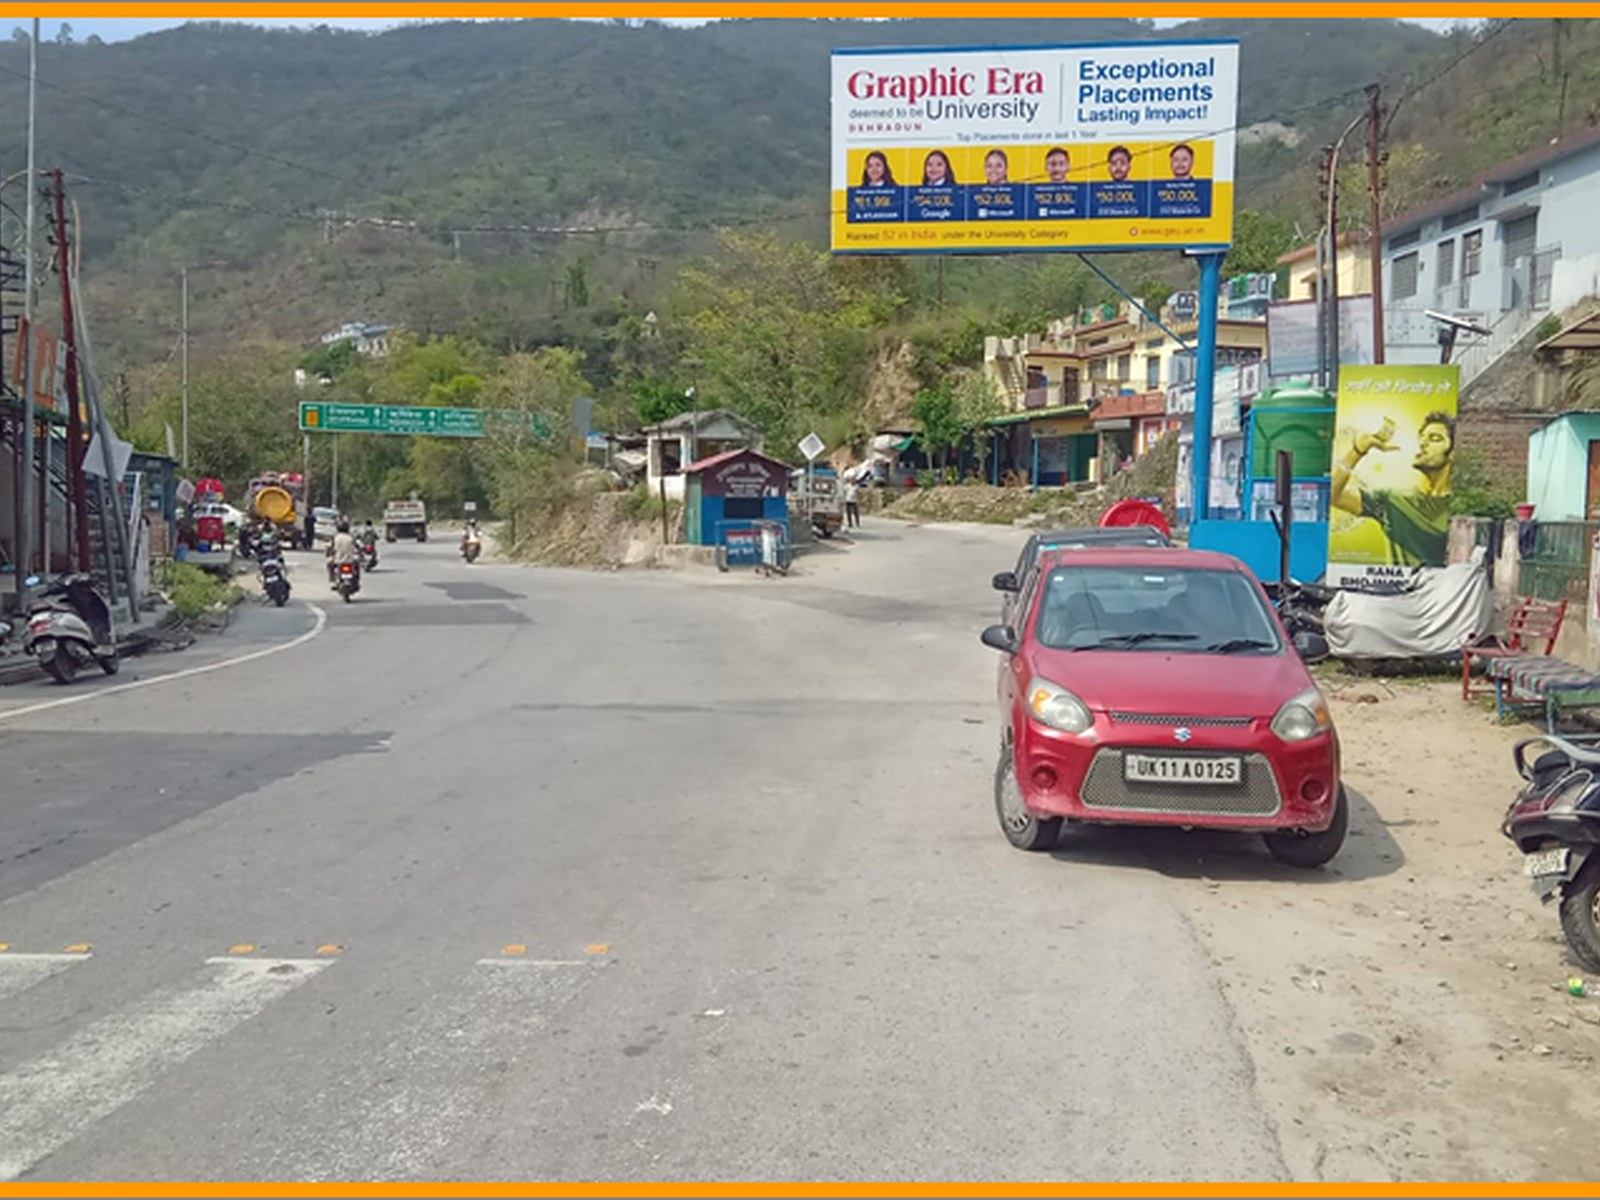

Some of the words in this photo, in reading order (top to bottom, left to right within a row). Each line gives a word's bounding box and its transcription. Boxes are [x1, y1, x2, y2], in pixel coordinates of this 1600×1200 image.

[1079, 57, 1215, 83] Exceptional
[847, 66, 976, 105] Graphic
[987, 67, 1044, 96] Era
[1079, 83, 1214, 104] Placements
[850, 107, 893, 119] deemed
[897, 106, 907, 118] to
[910, 106, 924, 118] be
[926, 98, 1040, 124] University
[1077, 106, 1141, 125] Lasting
[1145, 105, 1208, 123] Impact!
[849, 122, 923, 132] DEHRADUN
[974, 132, 1020, 141] Placements
[921, 208, 951, 219] Google
[911, 229, 937, 239] India
[942, 230, 965, 239] under
[969, 229, 982, 239] the
[984, 228, 1025, 240] University
[1029, 227, 1068, 240] Category
[1366, 566, 1404, 578] RANA
